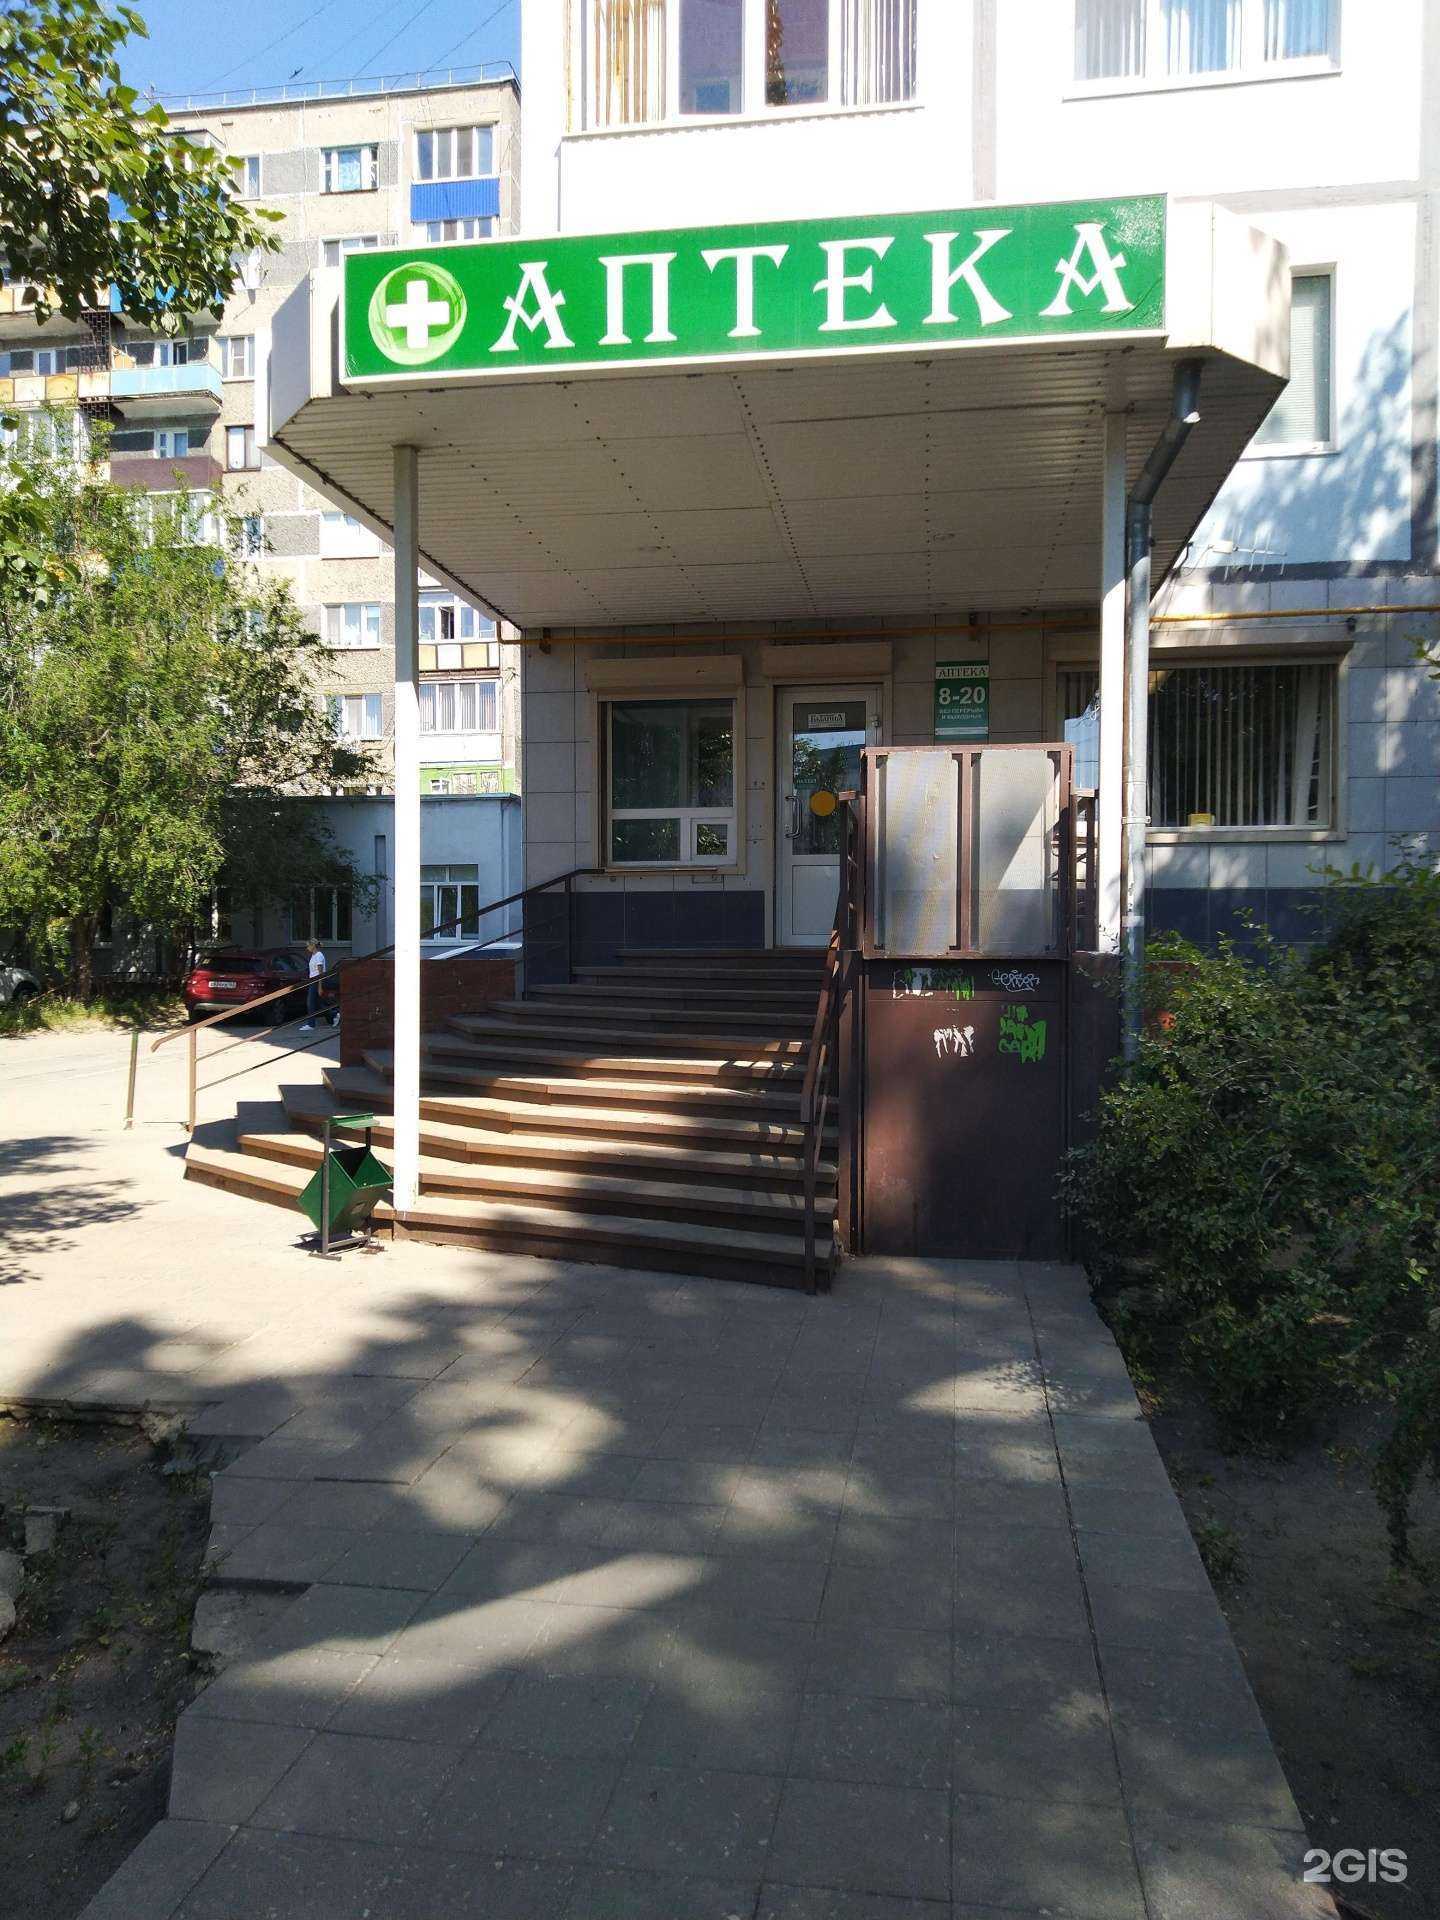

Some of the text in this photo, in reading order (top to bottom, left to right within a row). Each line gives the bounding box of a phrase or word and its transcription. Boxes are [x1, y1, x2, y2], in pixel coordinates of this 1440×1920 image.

[488, 221, 1136, 352] АПТЕКА
[938, 666, 986, 677] АПТЕКА
[938, 686, 986, 704] 8-20
